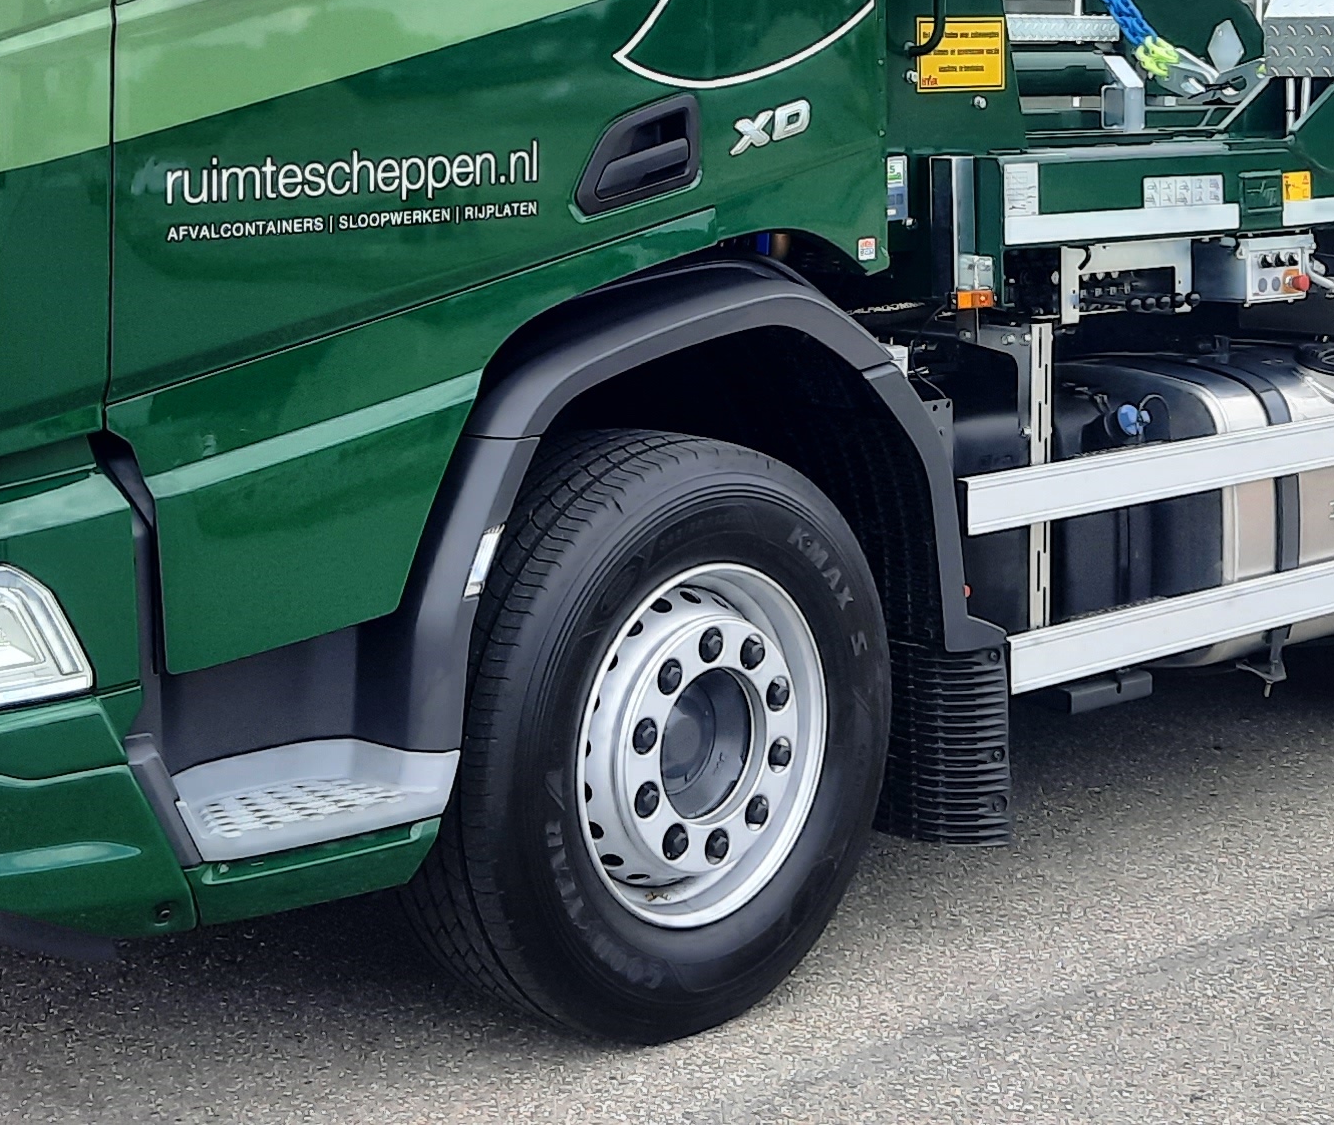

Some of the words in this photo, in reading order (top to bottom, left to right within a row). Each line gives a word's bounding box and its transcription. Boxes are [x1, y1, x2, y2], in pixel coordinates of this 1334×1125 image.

[729, 99, 811, 156] XD
[166, 140, 539, 205] ruimtescheppen.nl
[167, 217, 325, 242] AFVALCONTAINERS
[338, 207, 451, 230] SLOOPWERKEN
[464, 201, 538, 220] RIJPLATEN
[787, 527, 854, 611] KMAX
